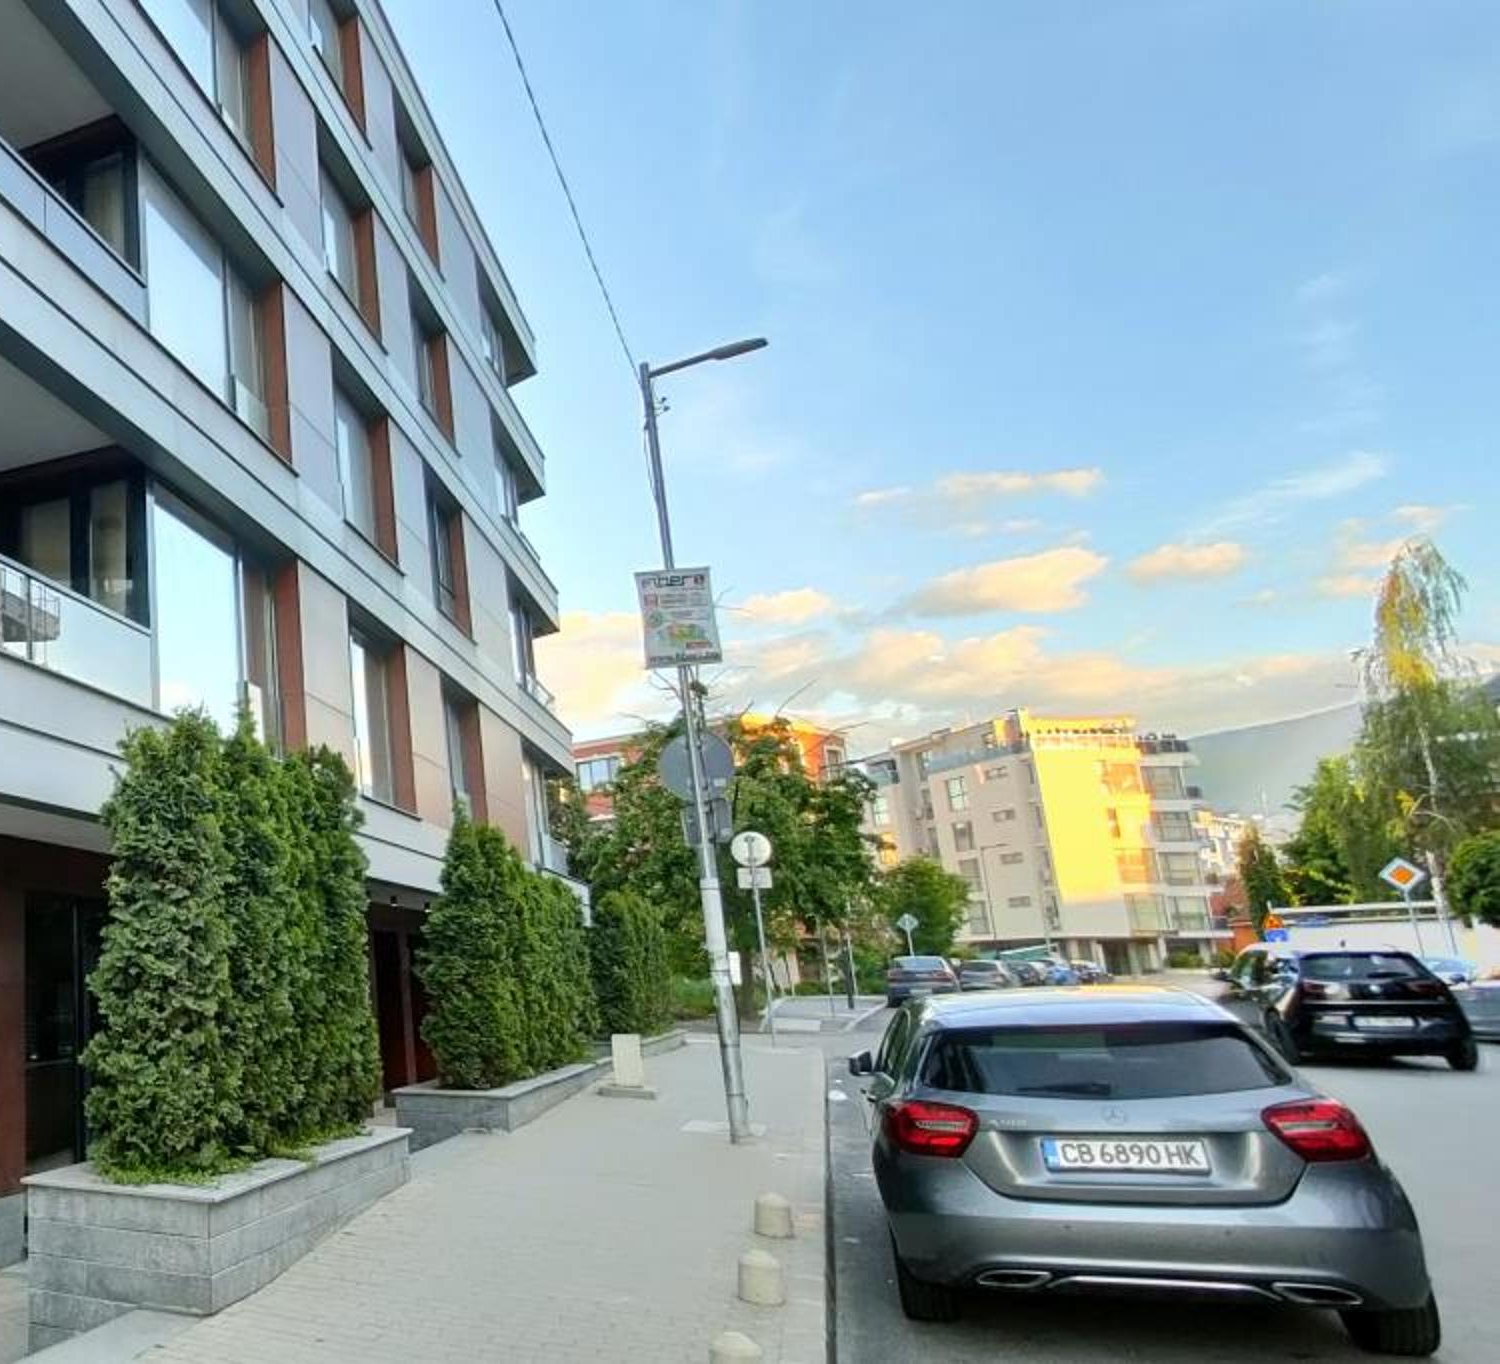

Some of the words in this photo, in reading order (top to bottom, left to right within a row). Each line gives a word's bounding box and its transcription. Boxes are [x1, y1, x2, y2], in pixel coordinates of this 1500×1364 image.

[1060, 1142, 1095, 1164] CB
[1100, 1144, 1161, 1165] 6890
[1167, 1145, 1200, 1166] HK
